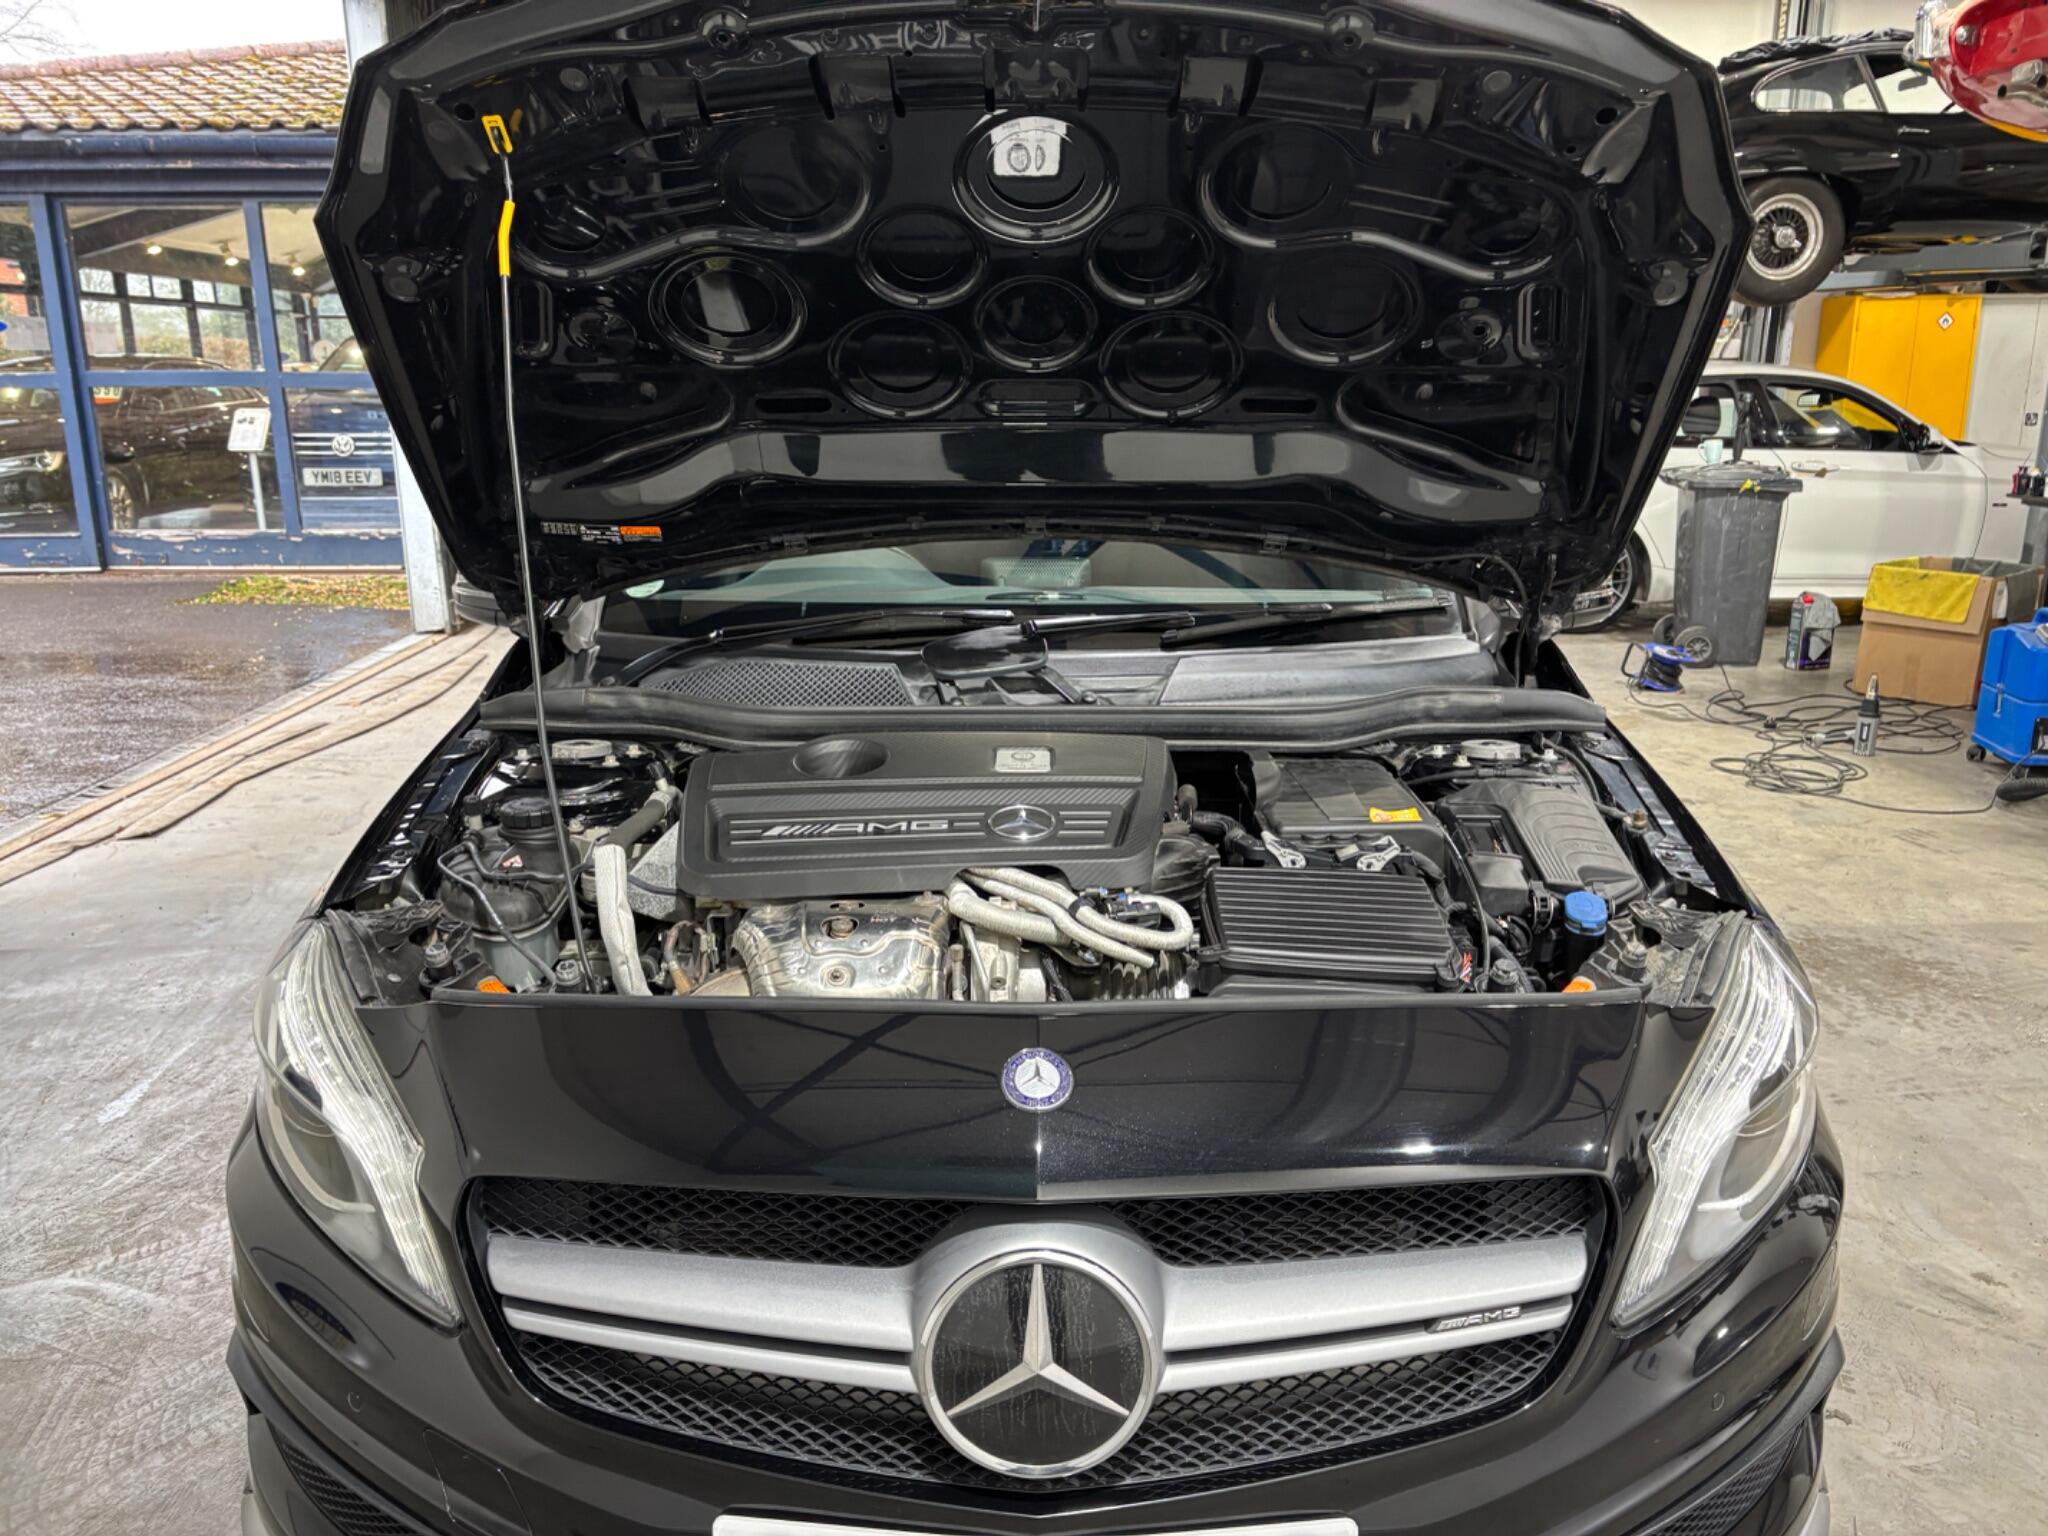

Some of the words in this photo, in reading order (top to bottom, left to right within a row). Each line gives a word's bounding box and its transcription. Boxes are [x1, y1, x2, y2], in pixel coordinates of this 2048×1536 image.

[311, 471, 343, 484] YM18
[346, 471, 372, 484] EEV
[824, 819, 949, 834] AMG
[1464, 1306, 1521, 1326] AMG
